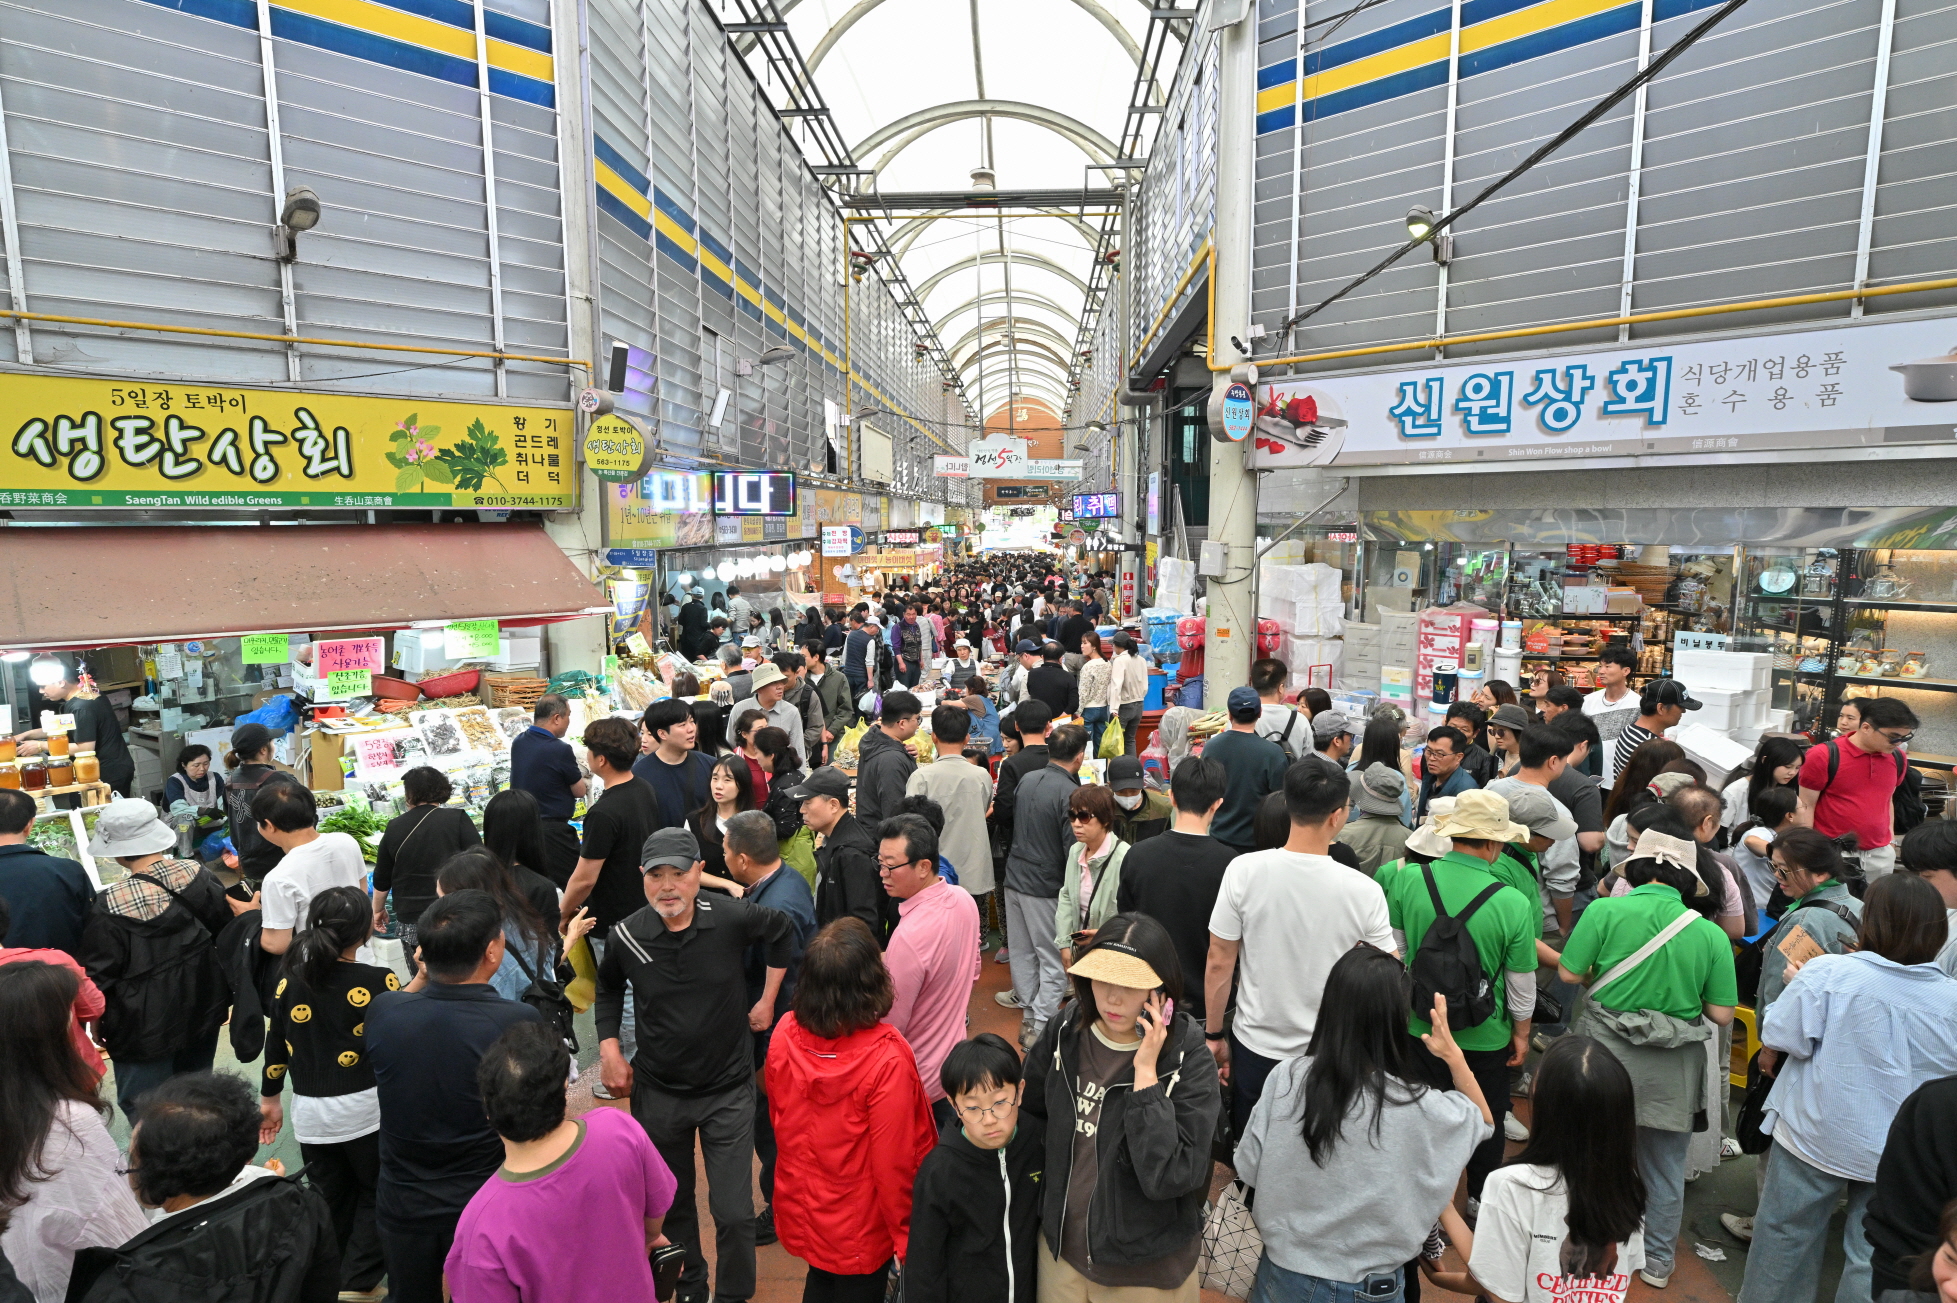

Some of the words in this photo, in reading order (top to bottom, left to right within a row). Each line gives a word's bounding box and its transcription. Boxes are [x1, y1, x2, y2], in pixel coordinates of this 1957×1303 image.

[1680, 351, 1847, 387] 식당개업용품
[111, 388, 173, 410] 5일장
[184, 392, 247, 414] 토박이
[1389, 355, 1673, 438] 신원상회
[1225, 406, 1250, 421] 신원상회
[596, 425, 610, 434] 정선
[612, 426, 633, 435] 토박이
[12, 407, 353, 483] 생탄상회
[515, 434, 559, 449] 곤드레
[587, 437, 642, 455] 생탄상회
[1508, 448, 1525, 456] Shin
[1526, 447, 1543, 456] Won
[1544, 446, 1563, 455] Flow
[1564, 446, 1583, 456] shop
[1591, 444, 1612, 453] bowl
[516, 452, 560, 467] 취나물
[596, 458, 630, 467] 563-1175
[125, 495, 181, 506] SaengTan
[185, 496, 209, 505] Wild
[212, 496, 244, 505] edible
[246, 496, 283, 505] Greens
[487, 496, 563, 506] 010-3744-1175
[320, 644, 346, 658] 농어촌
[1680, 637, 1726, 650] 비닐봉투
[332, 657, 370, 668] 사용가능
[1077, 1096, 1095, 1115] W
